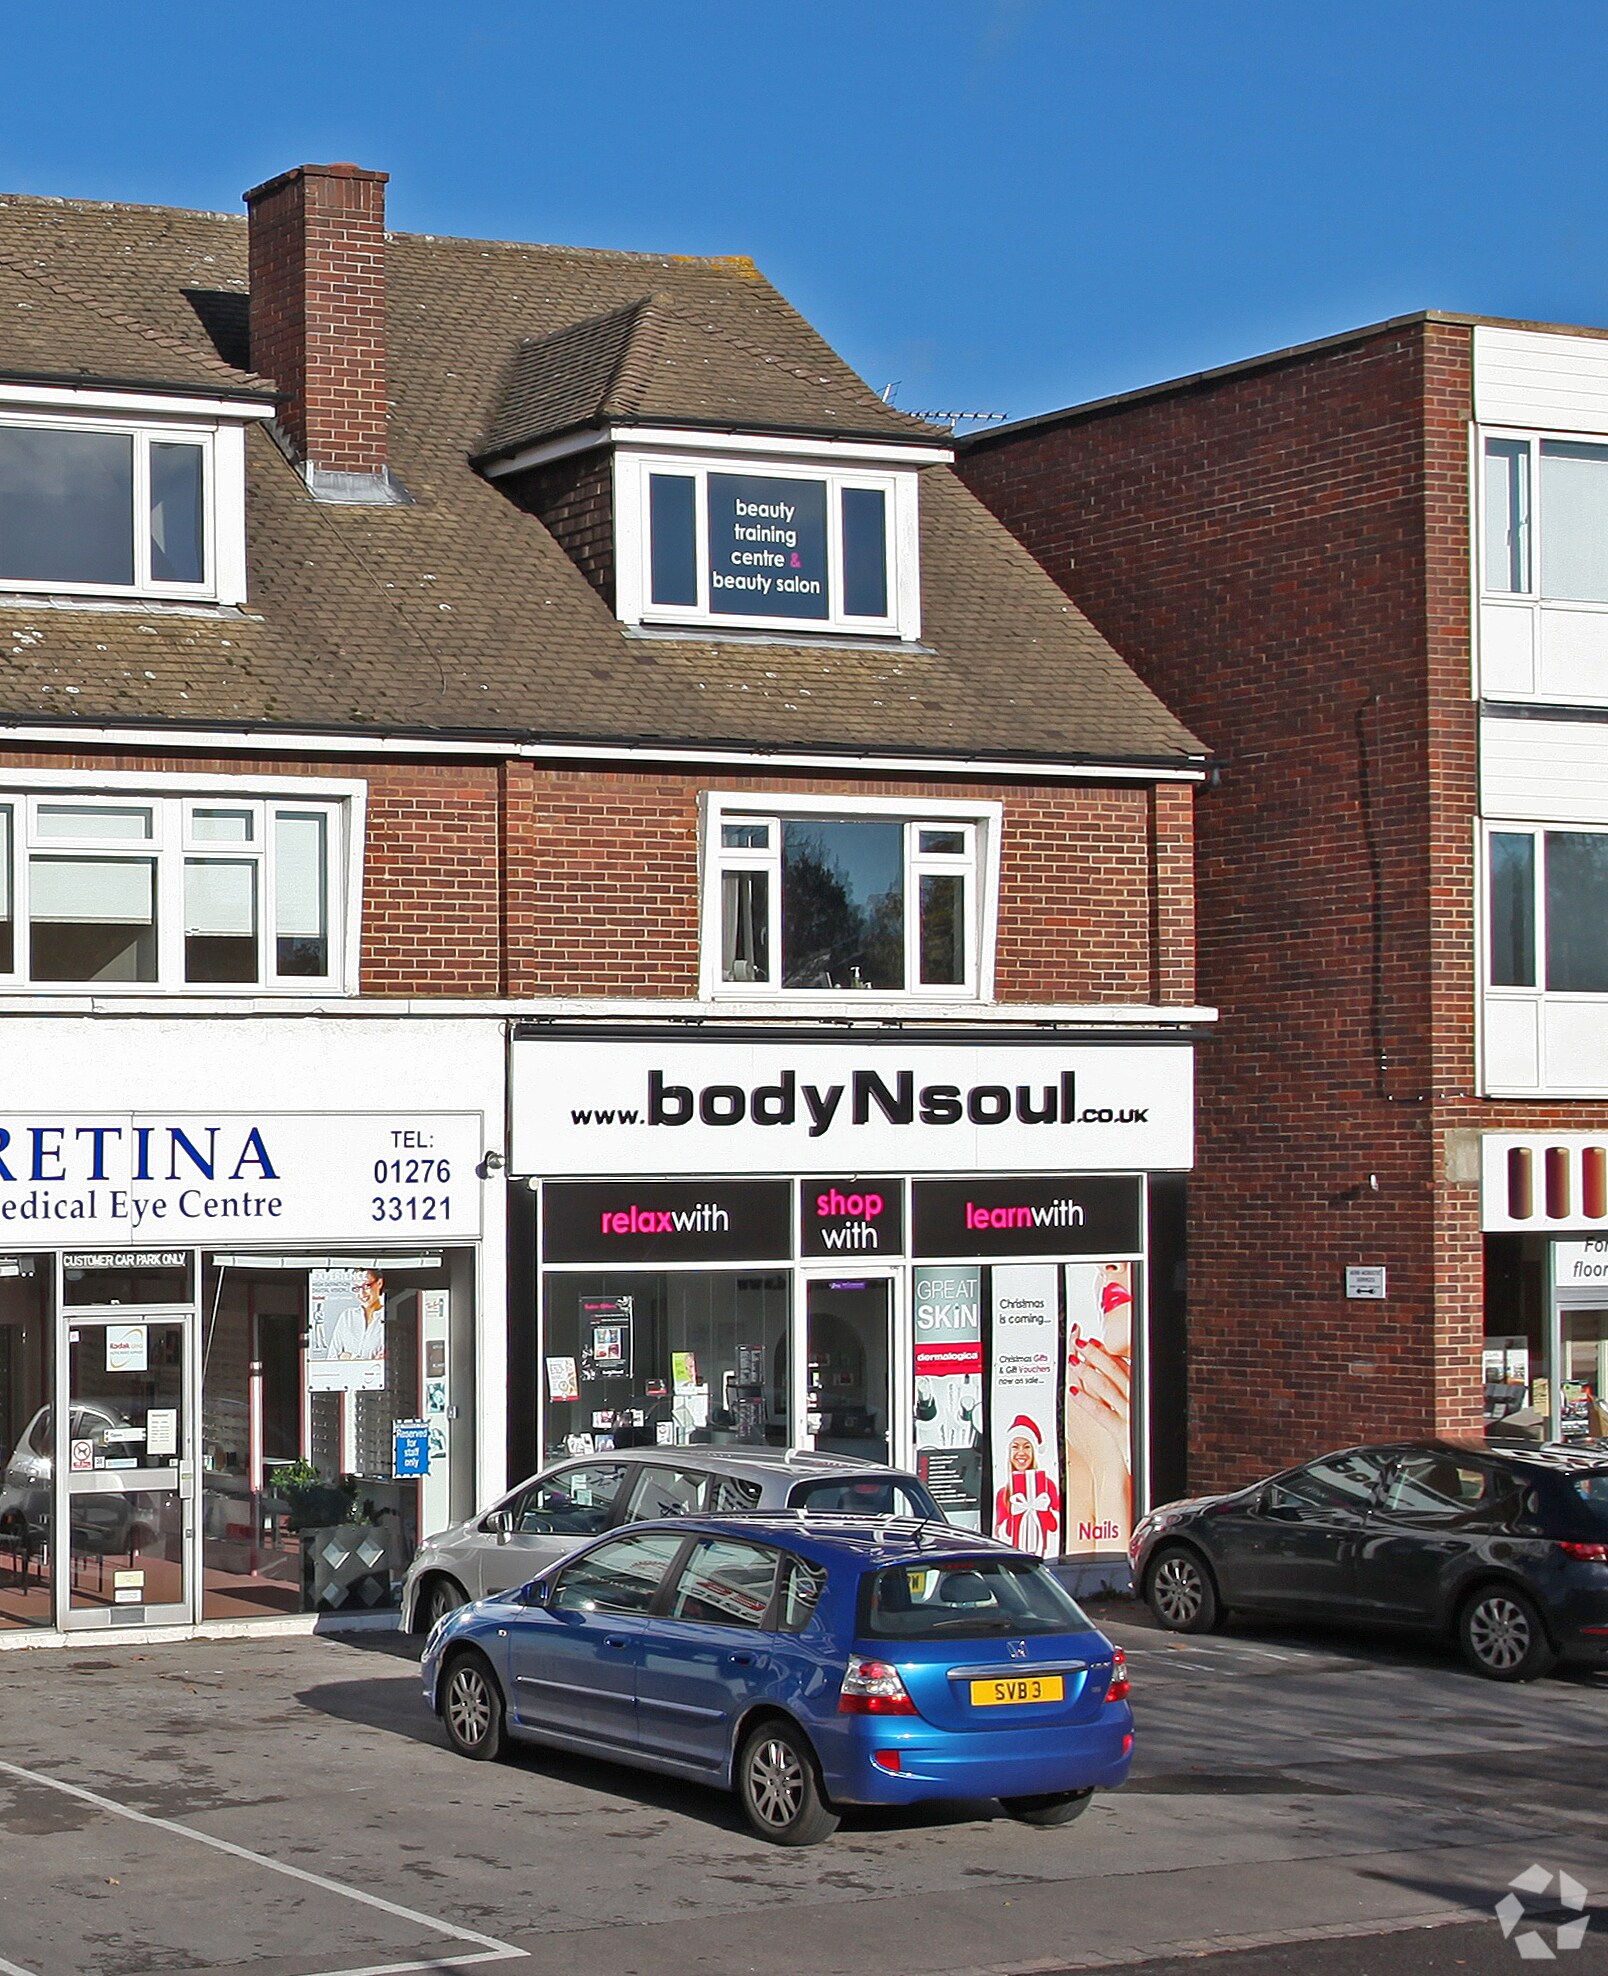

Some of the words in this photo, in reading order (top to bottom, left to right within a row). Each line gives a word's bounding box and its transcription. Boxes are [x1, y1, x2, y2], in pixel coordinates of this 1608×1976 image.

[735, 498, 796, 522] beauty
[734, 523, 797, 547] training
[731, 550, 785, 567] centre
[789, 552, 802, 568] &
[712, 571, 772, 595] beauty
[776, 576, 820, 594] salon
[390, 1130, 434, 1149] TEL:
[373, 1158, 451, 1184] 01276
[109, 1190, 167, 1228] Eye
[179, 1189, 283, 1218] Centre
[371, 1195, 450, 1221] 33121
[816, 1188, 884, 1221] shop
[821, 1221, 879, 1249] with
[63, 1253, 114, 1267] CUSTOMER
[115, 1253, 135, 1266] CAR
[136, 1253, 161, 1266] PARK
[916, 1279, 978, 1300] GREAT
[999, 1298, 1045, 1309] Christmas
[999, 1313, 1006, 1324] is
[916, 1350, 979, 1362] dermalogica
[999, 1355, 1032, 1363] Christmas
[396, 1428, 428, 1438] Reserved
[1078, 1520, 1119, 1541] Nails
[994, 1681, 1027, 1701] SVB
[1031, 1680, 1042, 1699] 3
